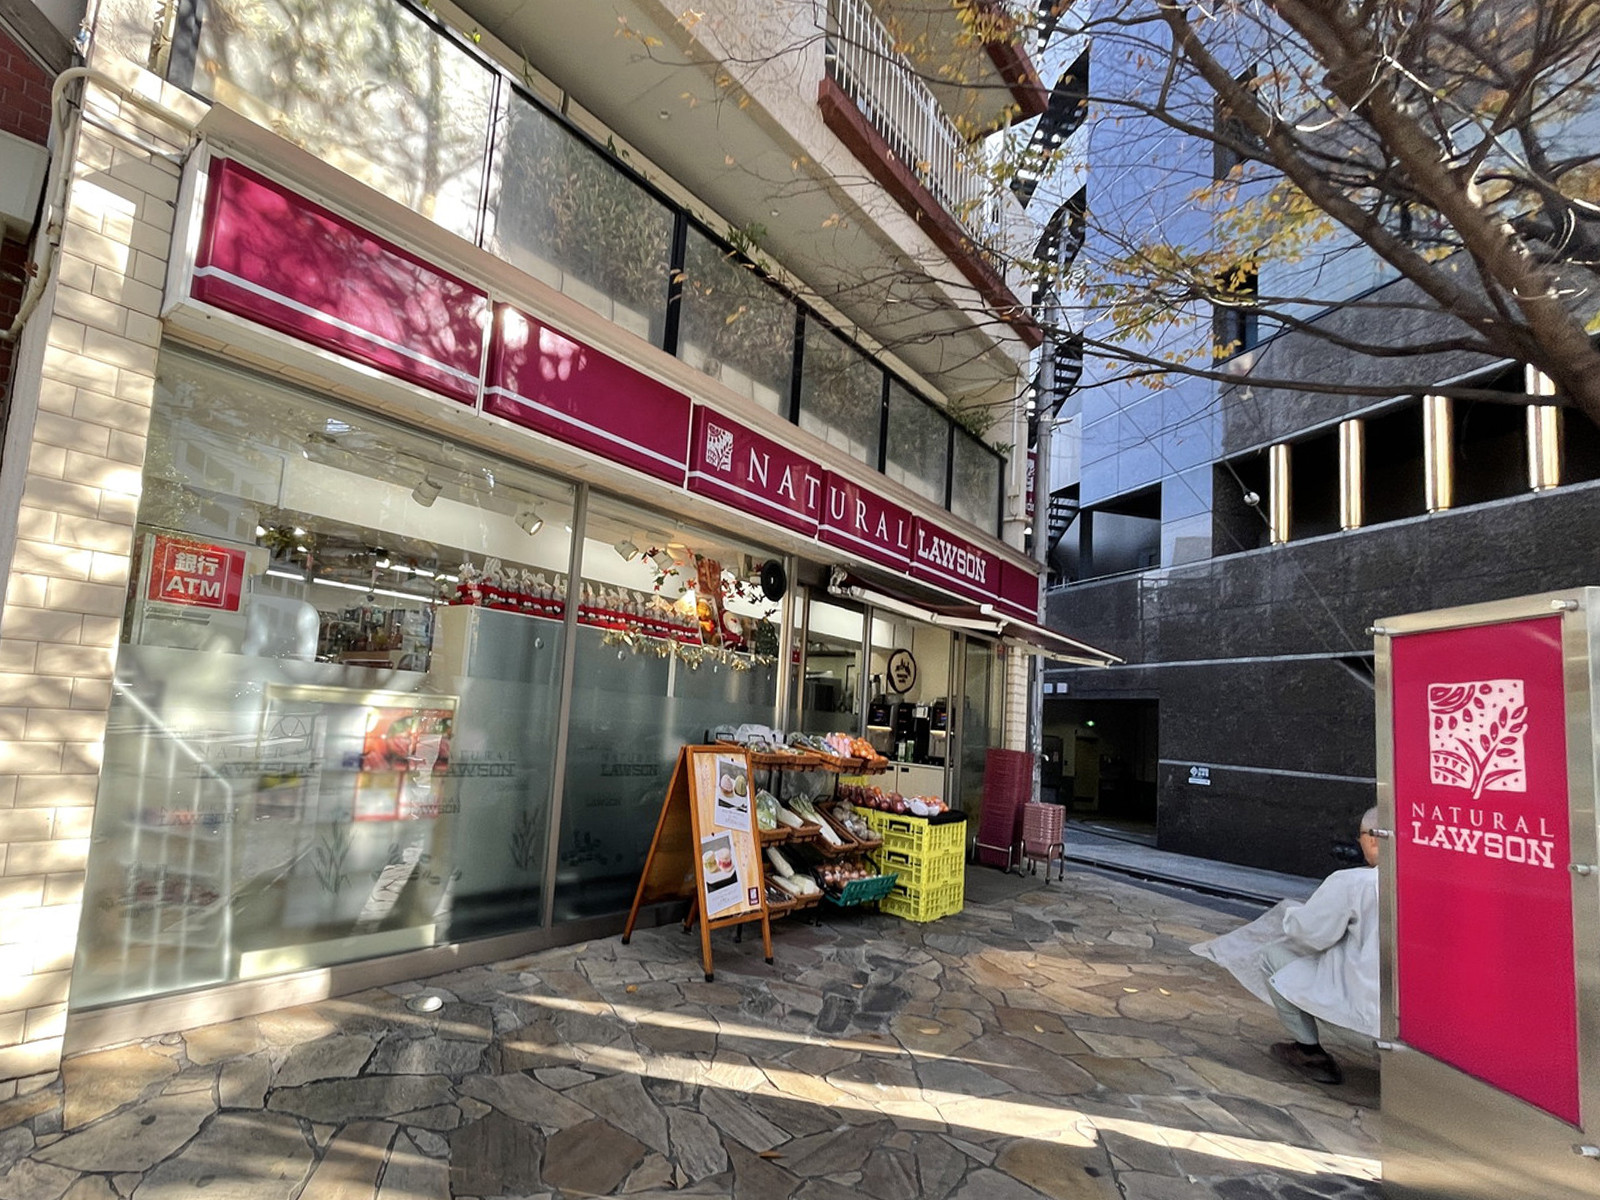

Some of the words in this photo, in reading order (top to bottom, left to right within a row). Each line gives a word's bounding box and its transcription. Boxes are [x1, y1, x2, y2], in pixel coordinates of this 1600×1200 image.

[747, 447, 909, 550] NATURAL
[918, 528, 987, 584] LAWSON
[174, 552, 219, 576] 銀行
[165, 575, 221, 598] ATM
[1411, 802, 1555, 838] NATURAL
[1411, 821, 1555, 869] LAWSON
